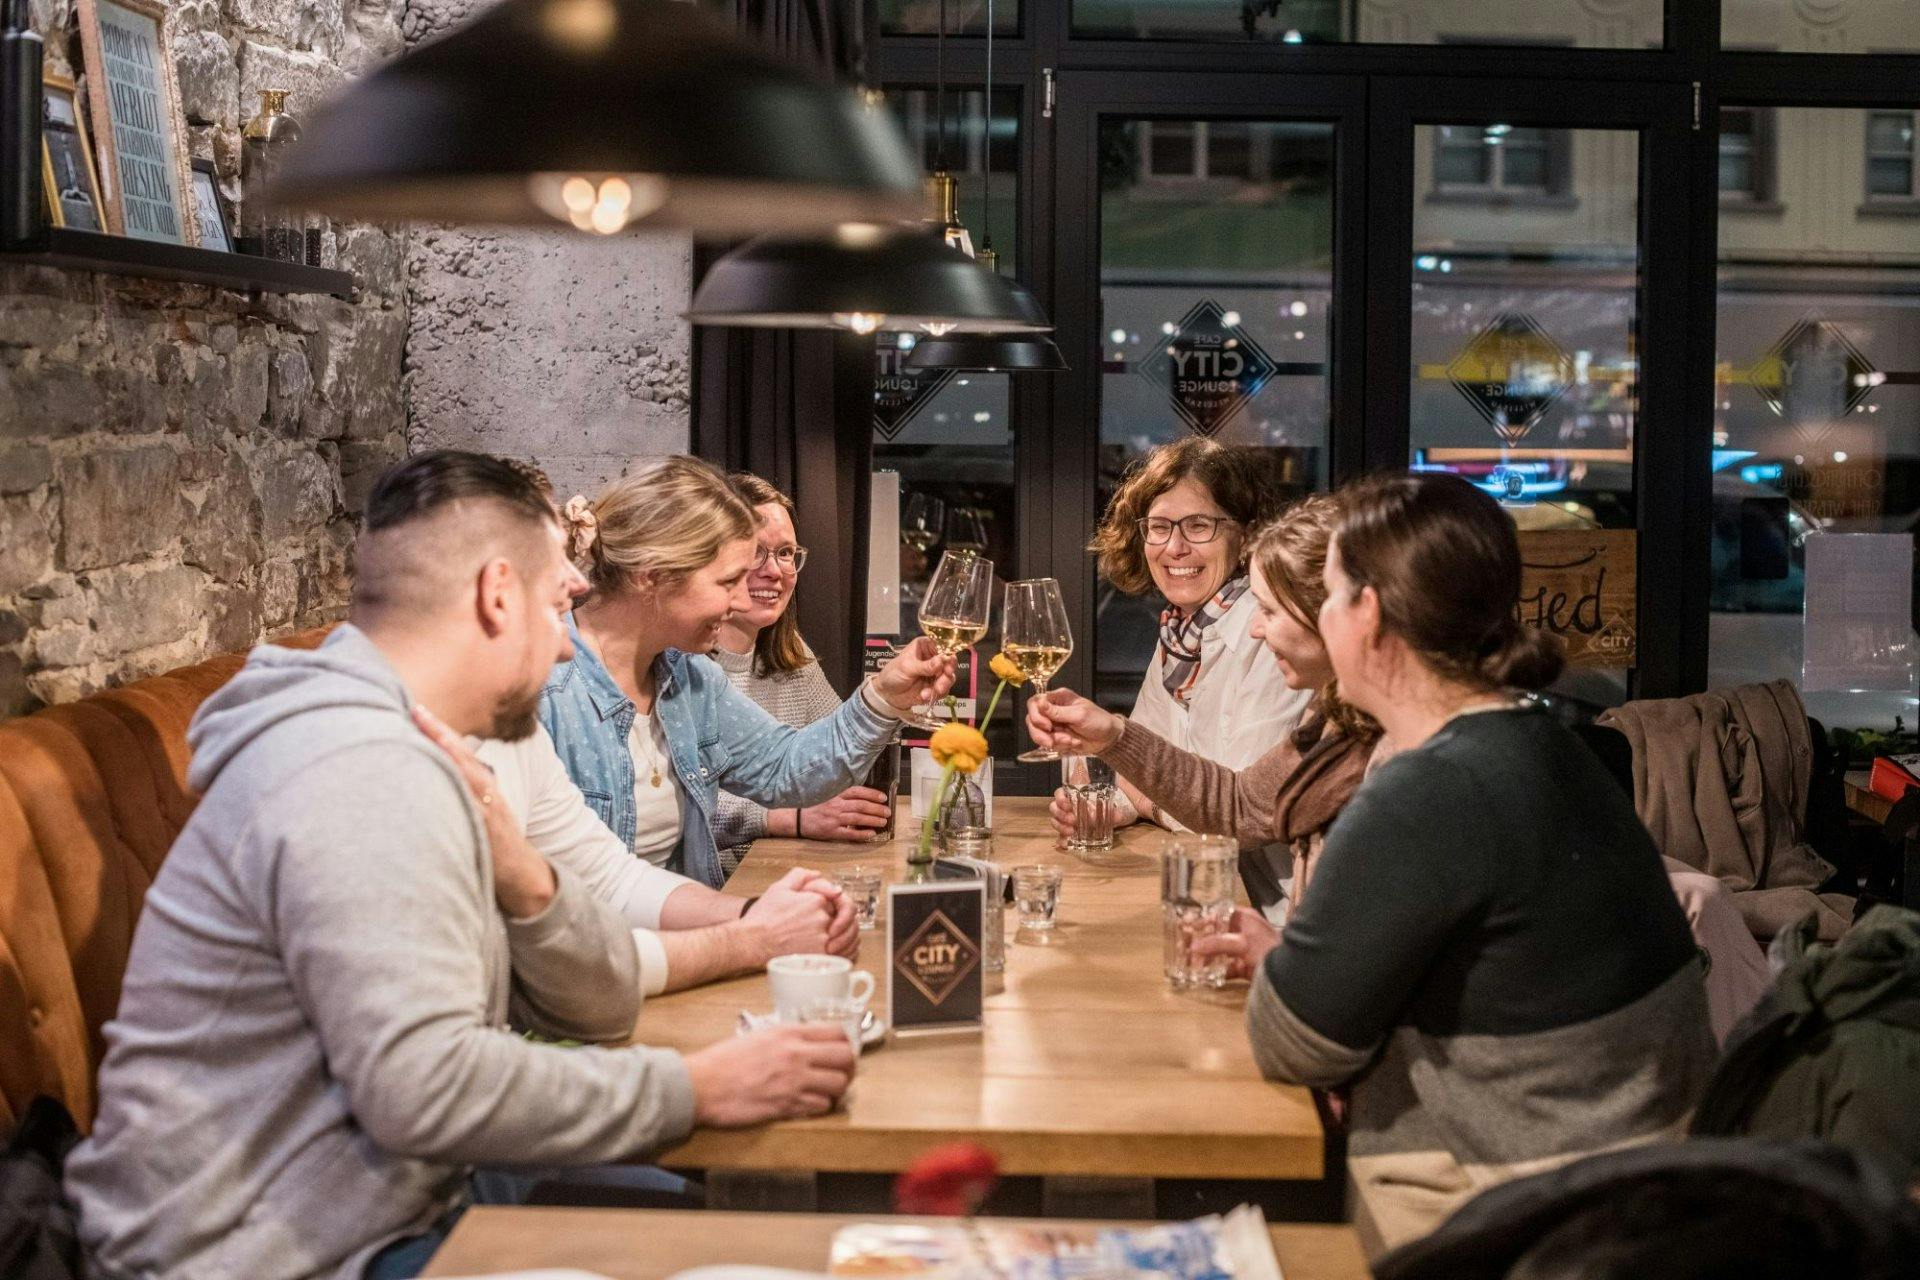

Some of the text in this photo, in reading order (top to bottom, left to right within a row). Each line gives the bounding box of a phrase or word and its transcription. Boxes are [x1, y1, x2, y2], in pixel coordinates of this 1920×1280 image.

[101, 20, 154, 69] BORDEAUX
[109, 79, 161, 134] MERLOT
[120, 157, 171, 203] RIESLING
[125, 198, 177, 237] PINOT NOIR
[865, 650, 897, 658] Jugendsc
[1601, 636, 1631, 648] CITY
[914, 943, 960, 965] CITY
